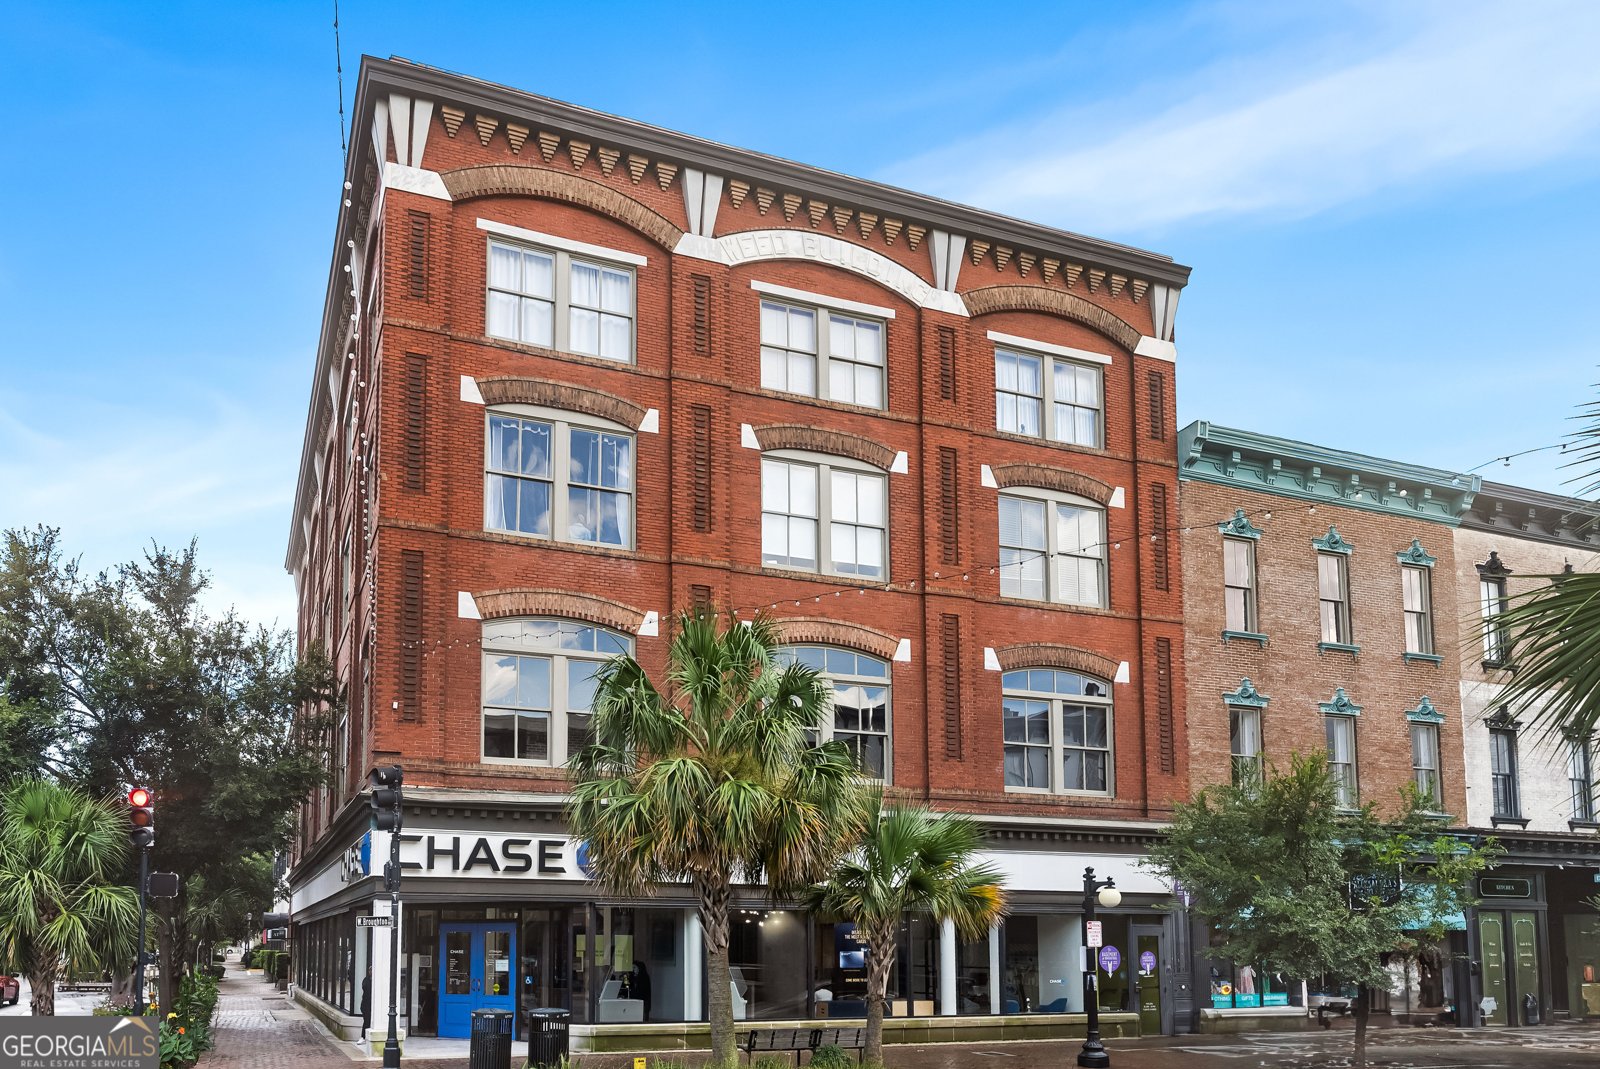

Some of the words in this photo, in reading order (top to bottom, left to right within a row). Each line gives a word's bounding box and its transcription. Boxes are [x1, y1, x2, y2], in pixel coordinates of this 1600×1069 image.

[720, 234, 787, 262] WEED
[802, 234, 930, 303] BUILDING
[400, 835, 567, 873] CHASE
